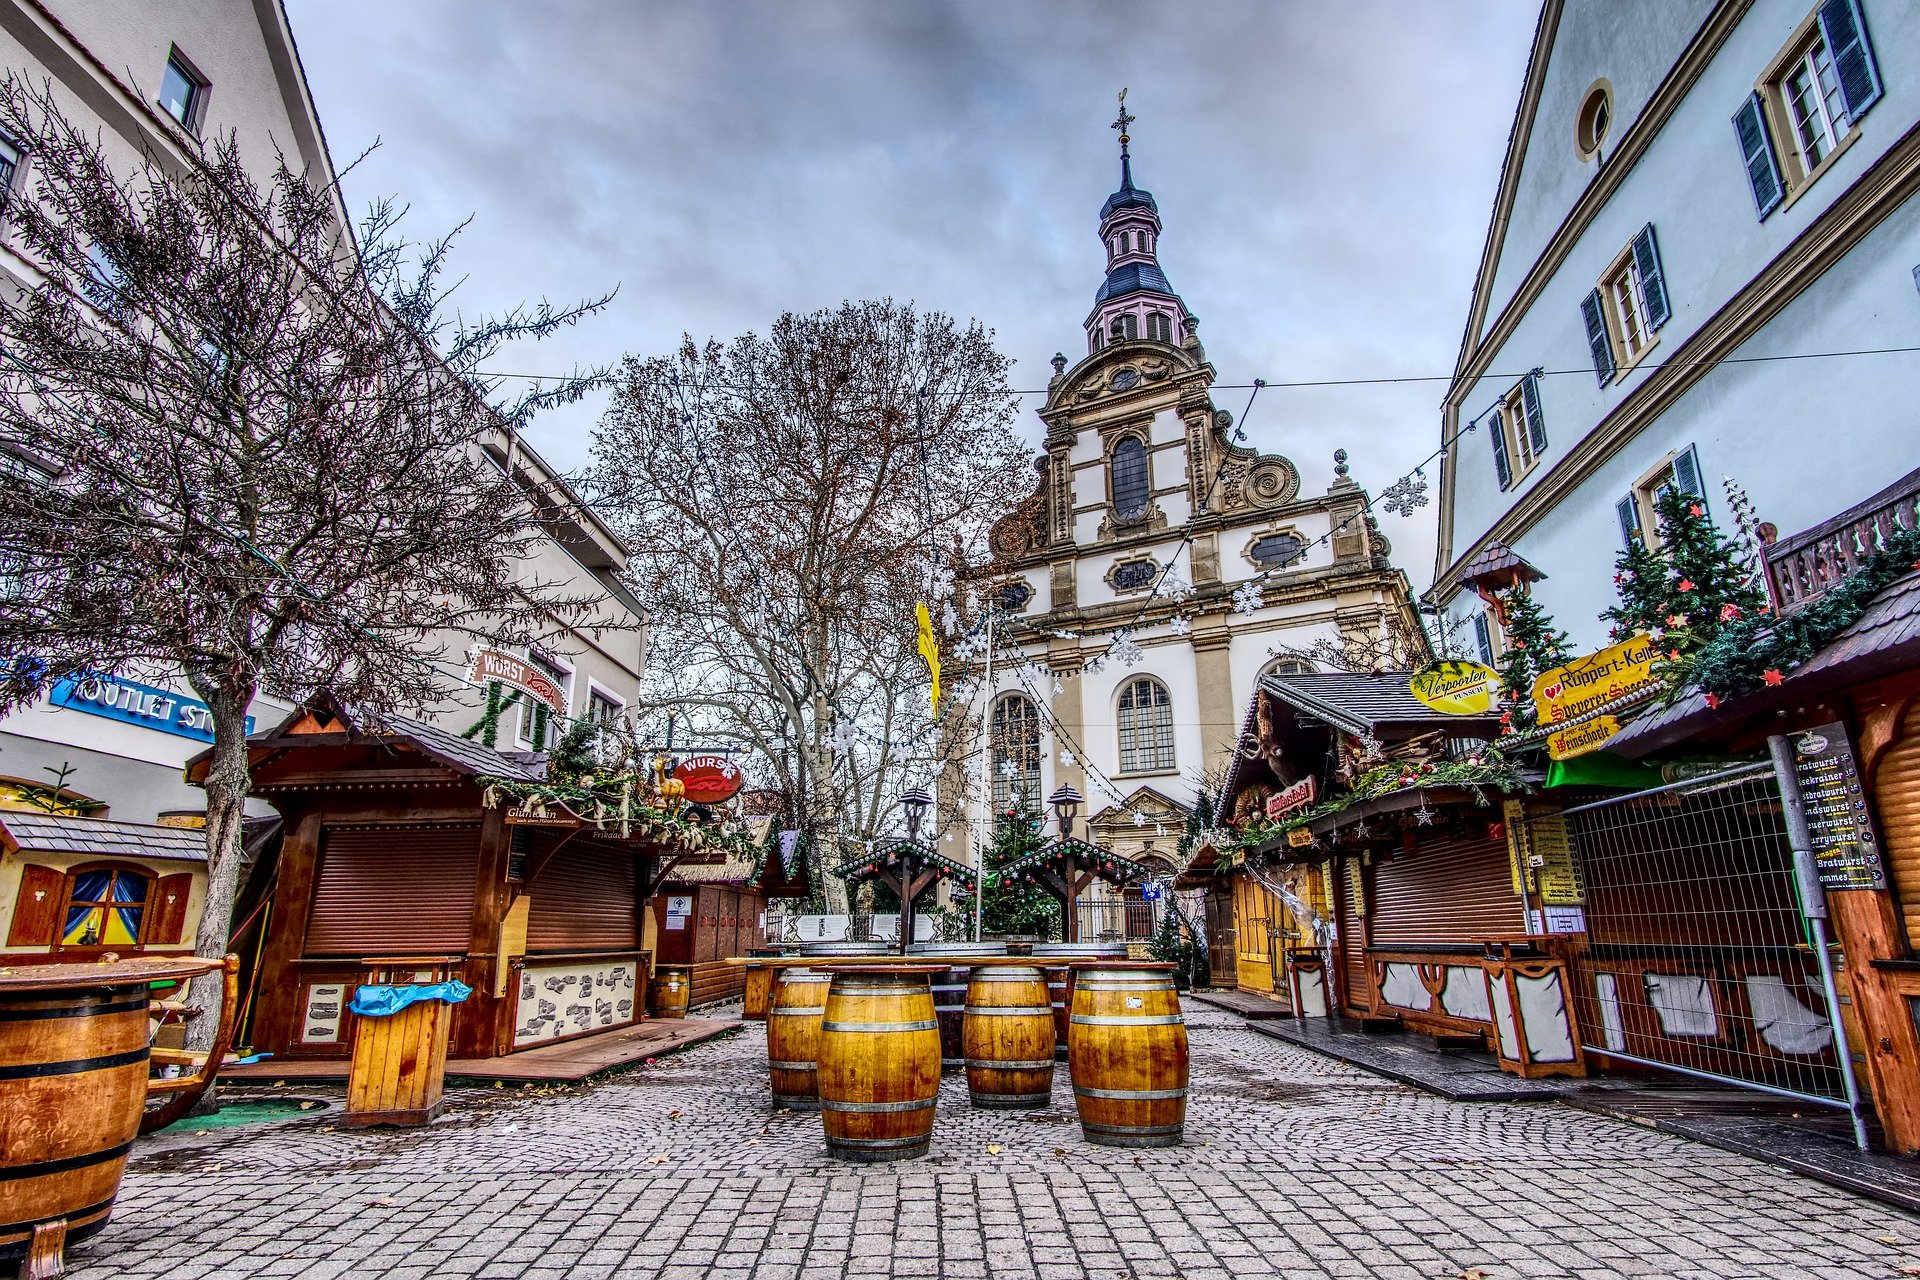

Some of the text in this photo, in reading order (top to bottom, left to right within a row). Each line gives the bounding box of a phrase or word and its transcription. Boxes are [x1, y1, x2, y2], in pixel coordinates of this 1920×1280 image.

[1559, 646, 1664, 691] Ruppert-Kelle
[484, 654, 555, 703] WURST Koch
[1420, 669, 1487, 698] Verpoorten
[78, 679, 177, 721] OUTLET
[1453, 686, 1484, 700] PUNSCH
[1554, 725, 1610, 753] Weinschorle
[684, 757, 737, 772] WURS
[1796, 756, 1838, 771] ratwurst
[682, 775, 734, 793] Koch
[1799, 772, 1843, 786] sekrainer
[508, 808, 557, 819] Glühwin
[1805, 802, 1850, 816] ndswurst
[593, 831, 624, 839] Frikade
[1817, 855, 1865, 868] Bratwurst
[1819, 874, 1848, 882] ommes
